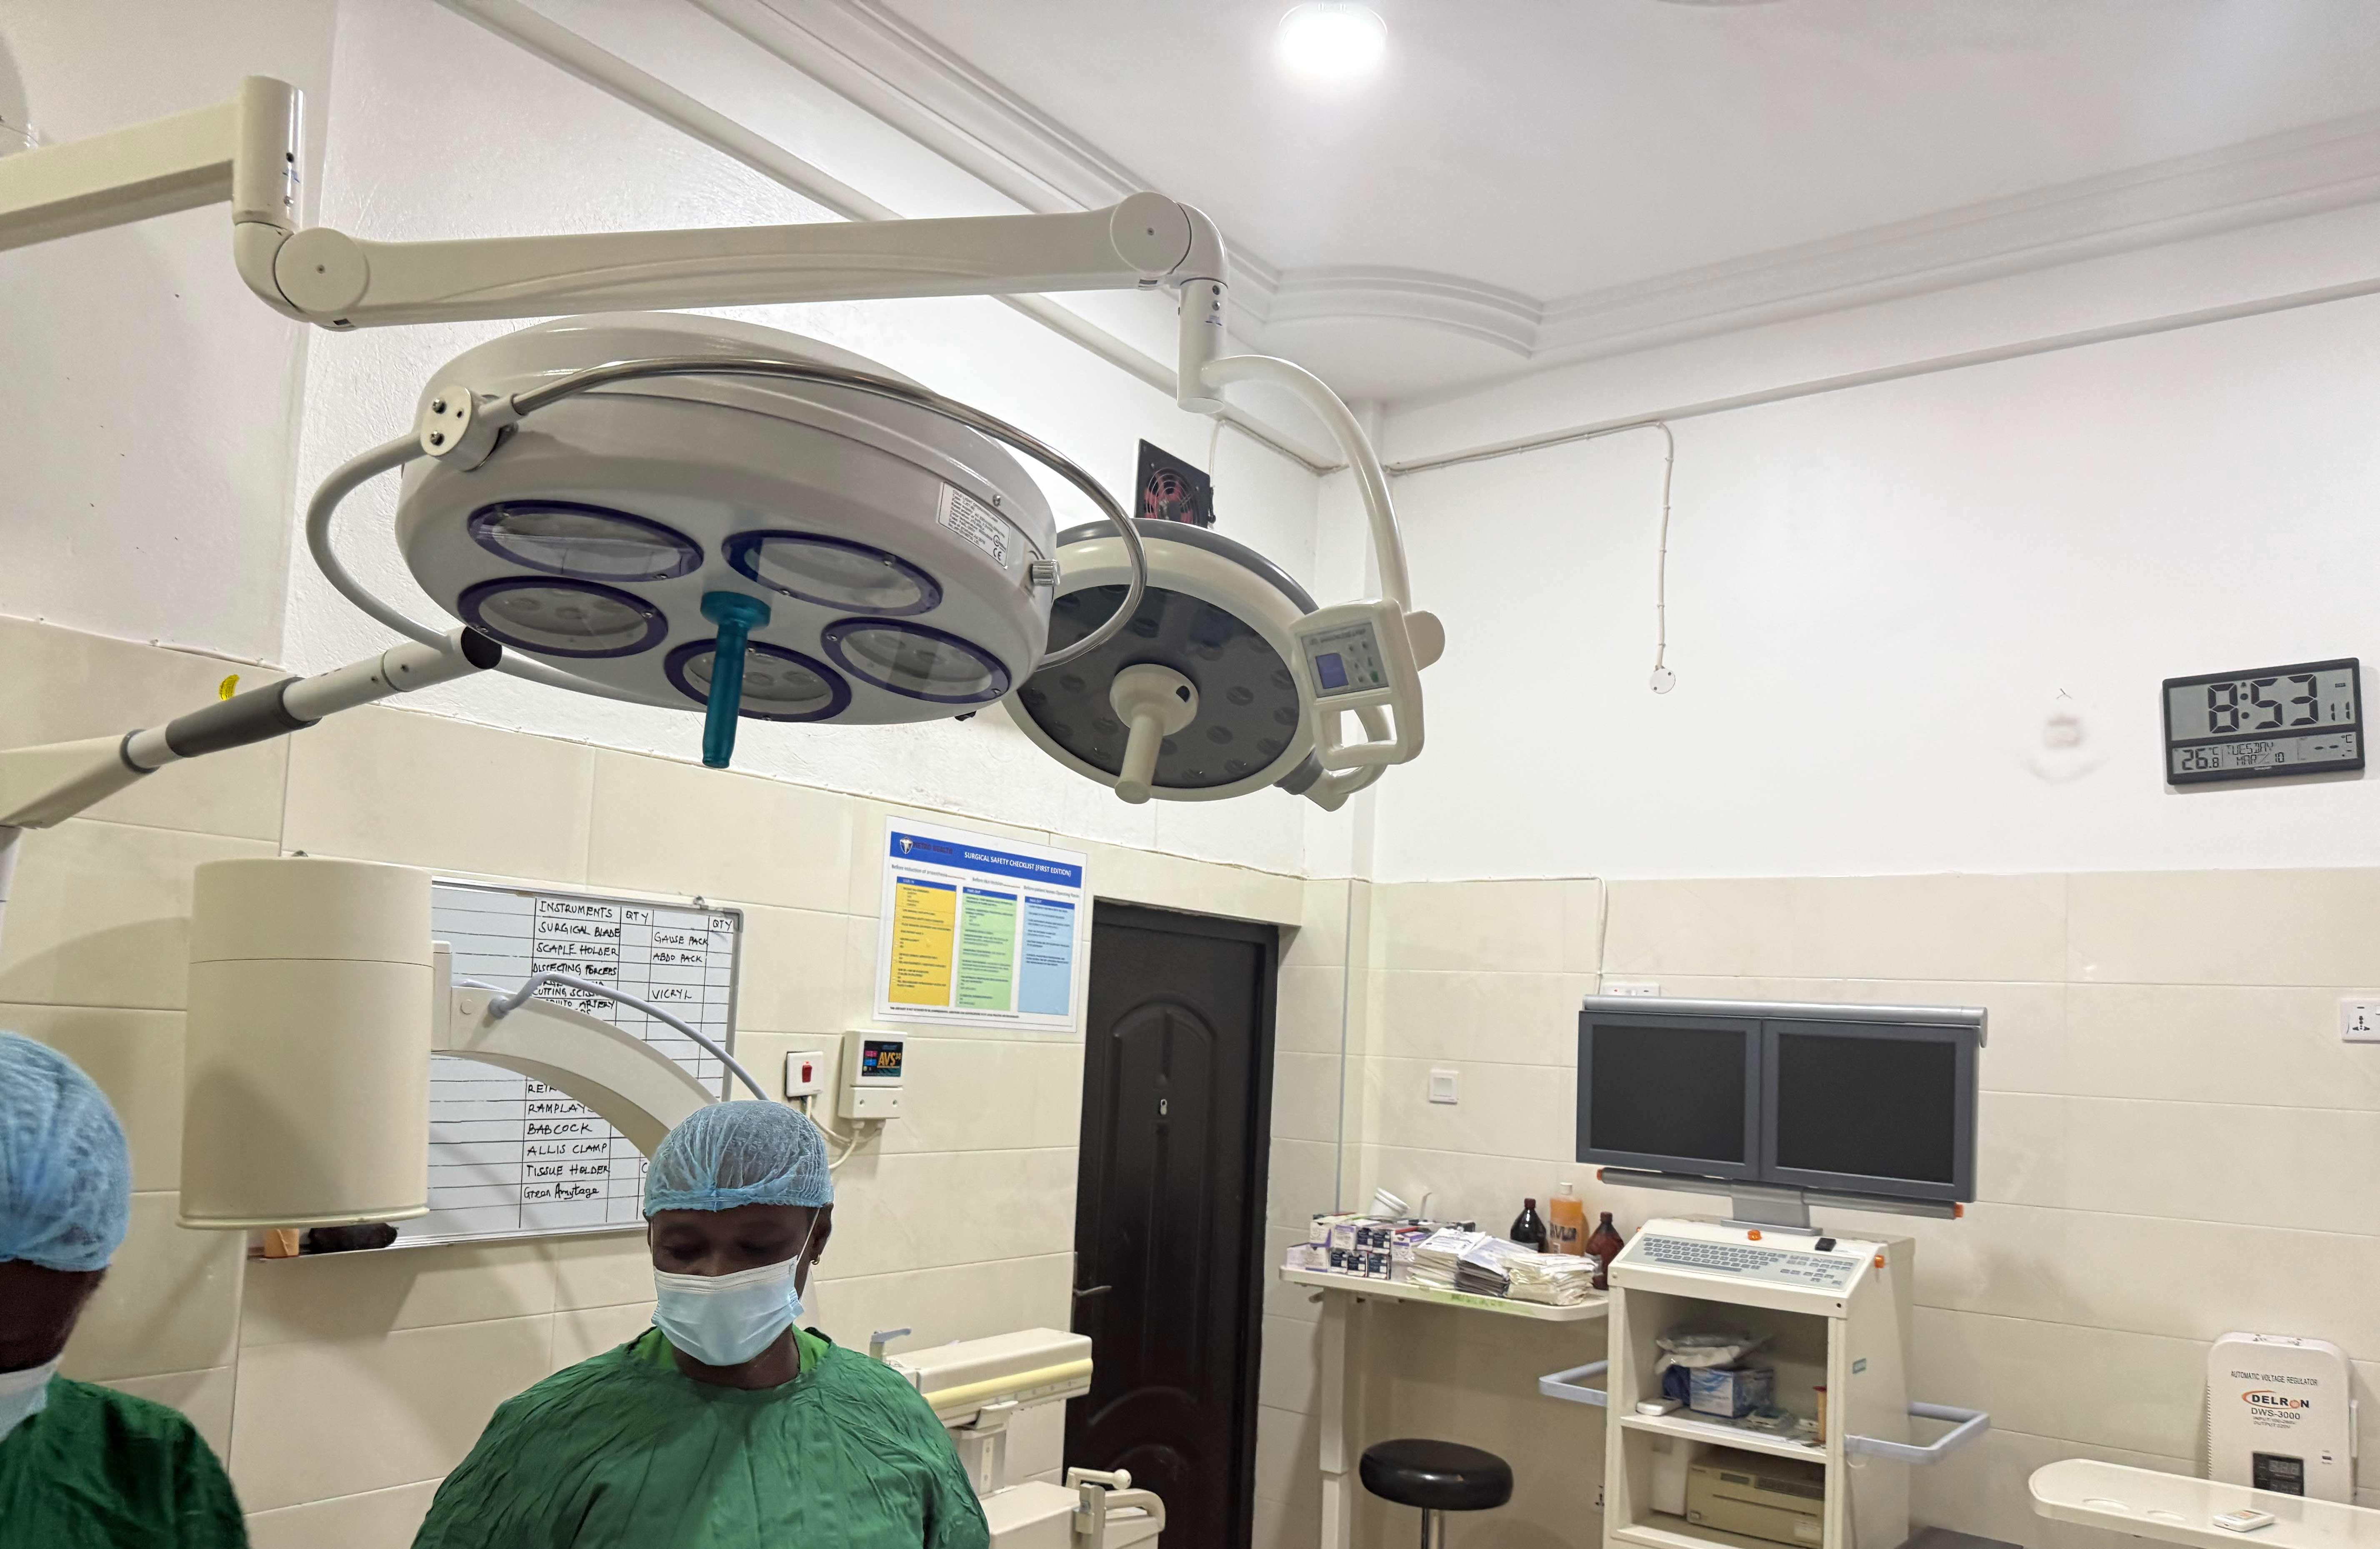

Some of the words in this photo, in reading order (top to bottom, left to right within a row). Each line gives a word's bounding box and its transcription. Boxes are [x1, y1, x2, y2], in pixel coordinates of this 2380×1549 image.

[2208, 674, 2318, 733] 8:53
[2226, 742, 2273, 755] TUESDAY
[965, 852, 990, 862] SURGICAL
[990, 857, 1009, 866] SAFETY
[1010, 860, 1034, 870] CHECKLIST
[539, 901, 613, 918] INSTRUMENTS
[626, 911, 648, 925] QTY
[538, 921, 591, 935] SURGICAL
[594, 926, 620, 937] BLADE
[713, 919, 732, 931] QTY
[689, 936, 708, 946] PACK
[537, 943, 577, 956] SCAPLE
[580, 945, 619, 956] HOLDER
[652, 953, 675, 962] ABDO
[680, 954, 702, 963] PACK
[585, 964, 617, 976] FORCEPS
[652, 989, 692, 1000] VICRYL
[579, 1000, 615, 1009] ARTERY
[527, 1123, 592, 1135] BABCOCK
[527, 1144, 566, 1156] ALLIS
[572, 1143, 608, 1154] CLAMP
[526, 1165, 563, 1177] TISSUE
[570, 1164, 610, 1175] HOLDER
[2231, 1371, 2259, 1380] AUTOMATIC
[2261, 1374, 2285, 1383] VOLTAGE
[2286, 1376, 2318, 1386] REGULATOR
[2252, 1394, 2309, 1409] DELRON
[2251, 1407, 2300, 1420] DWS-3000
